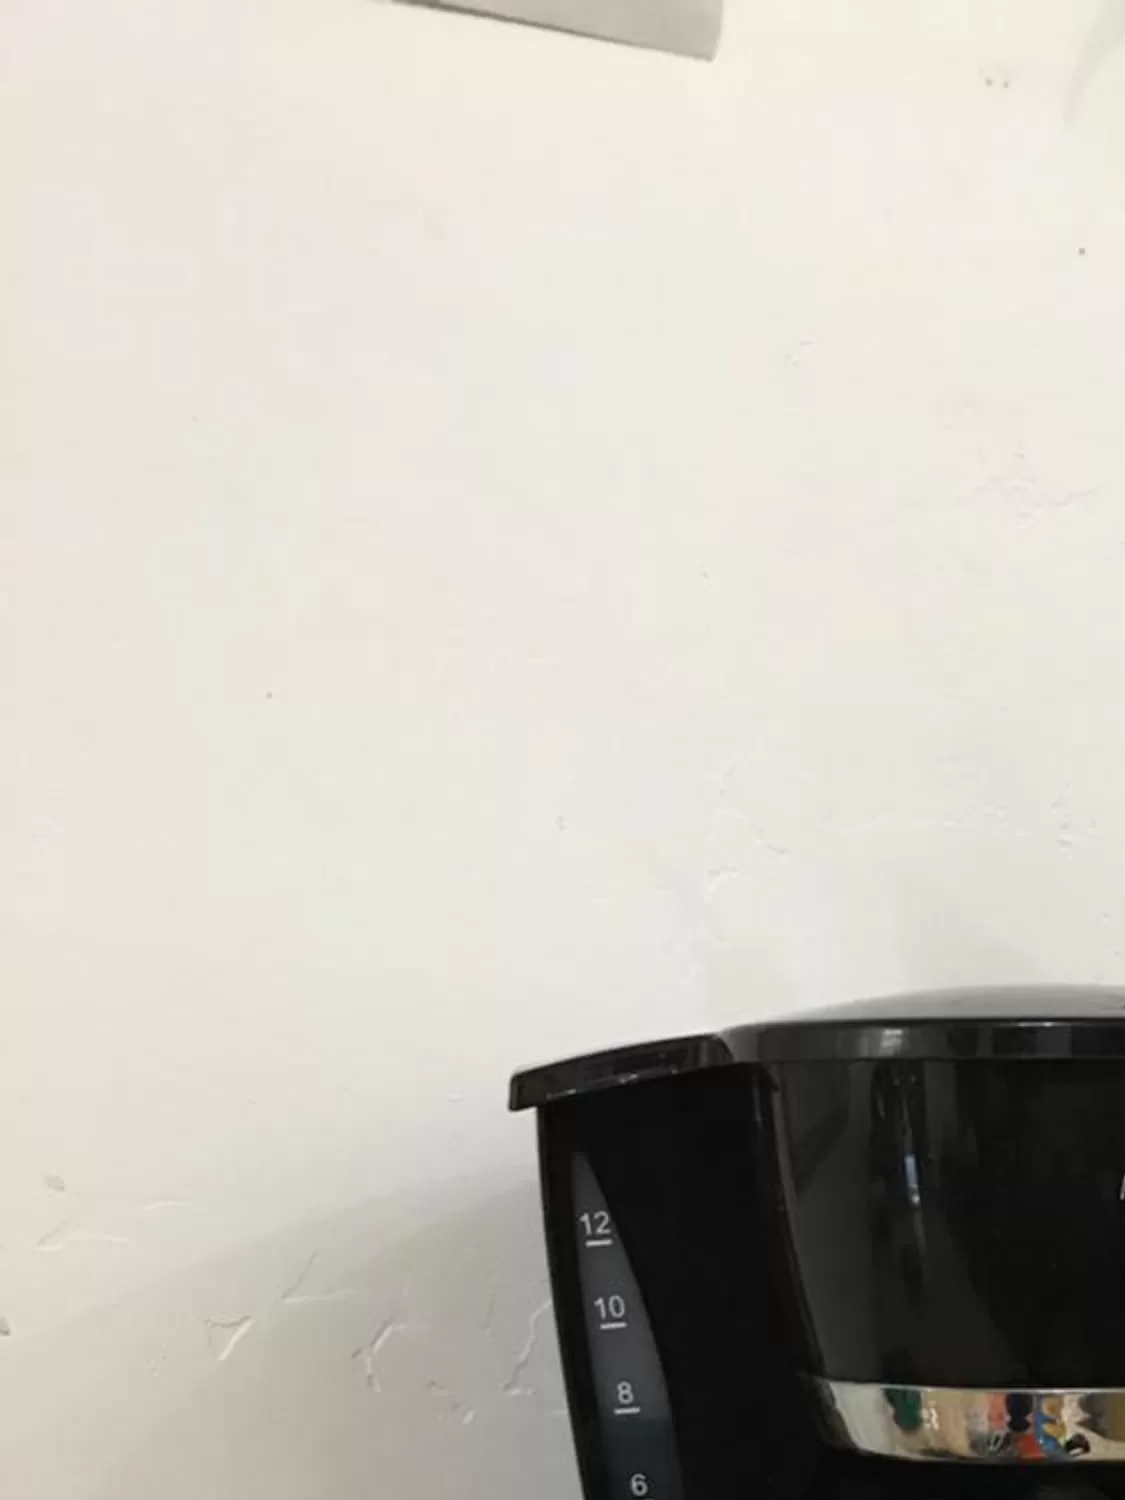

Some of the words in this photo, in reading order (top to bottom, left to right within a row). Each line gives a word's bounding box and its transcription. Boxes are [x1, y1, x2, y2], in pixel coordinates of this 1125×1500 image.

[579, 1211, 611, 1236] 12
[594, 1296, 626, 1319] 10
[617, 1381, 635, 1404] 8
[630, 1474, 648, 1496] 6
